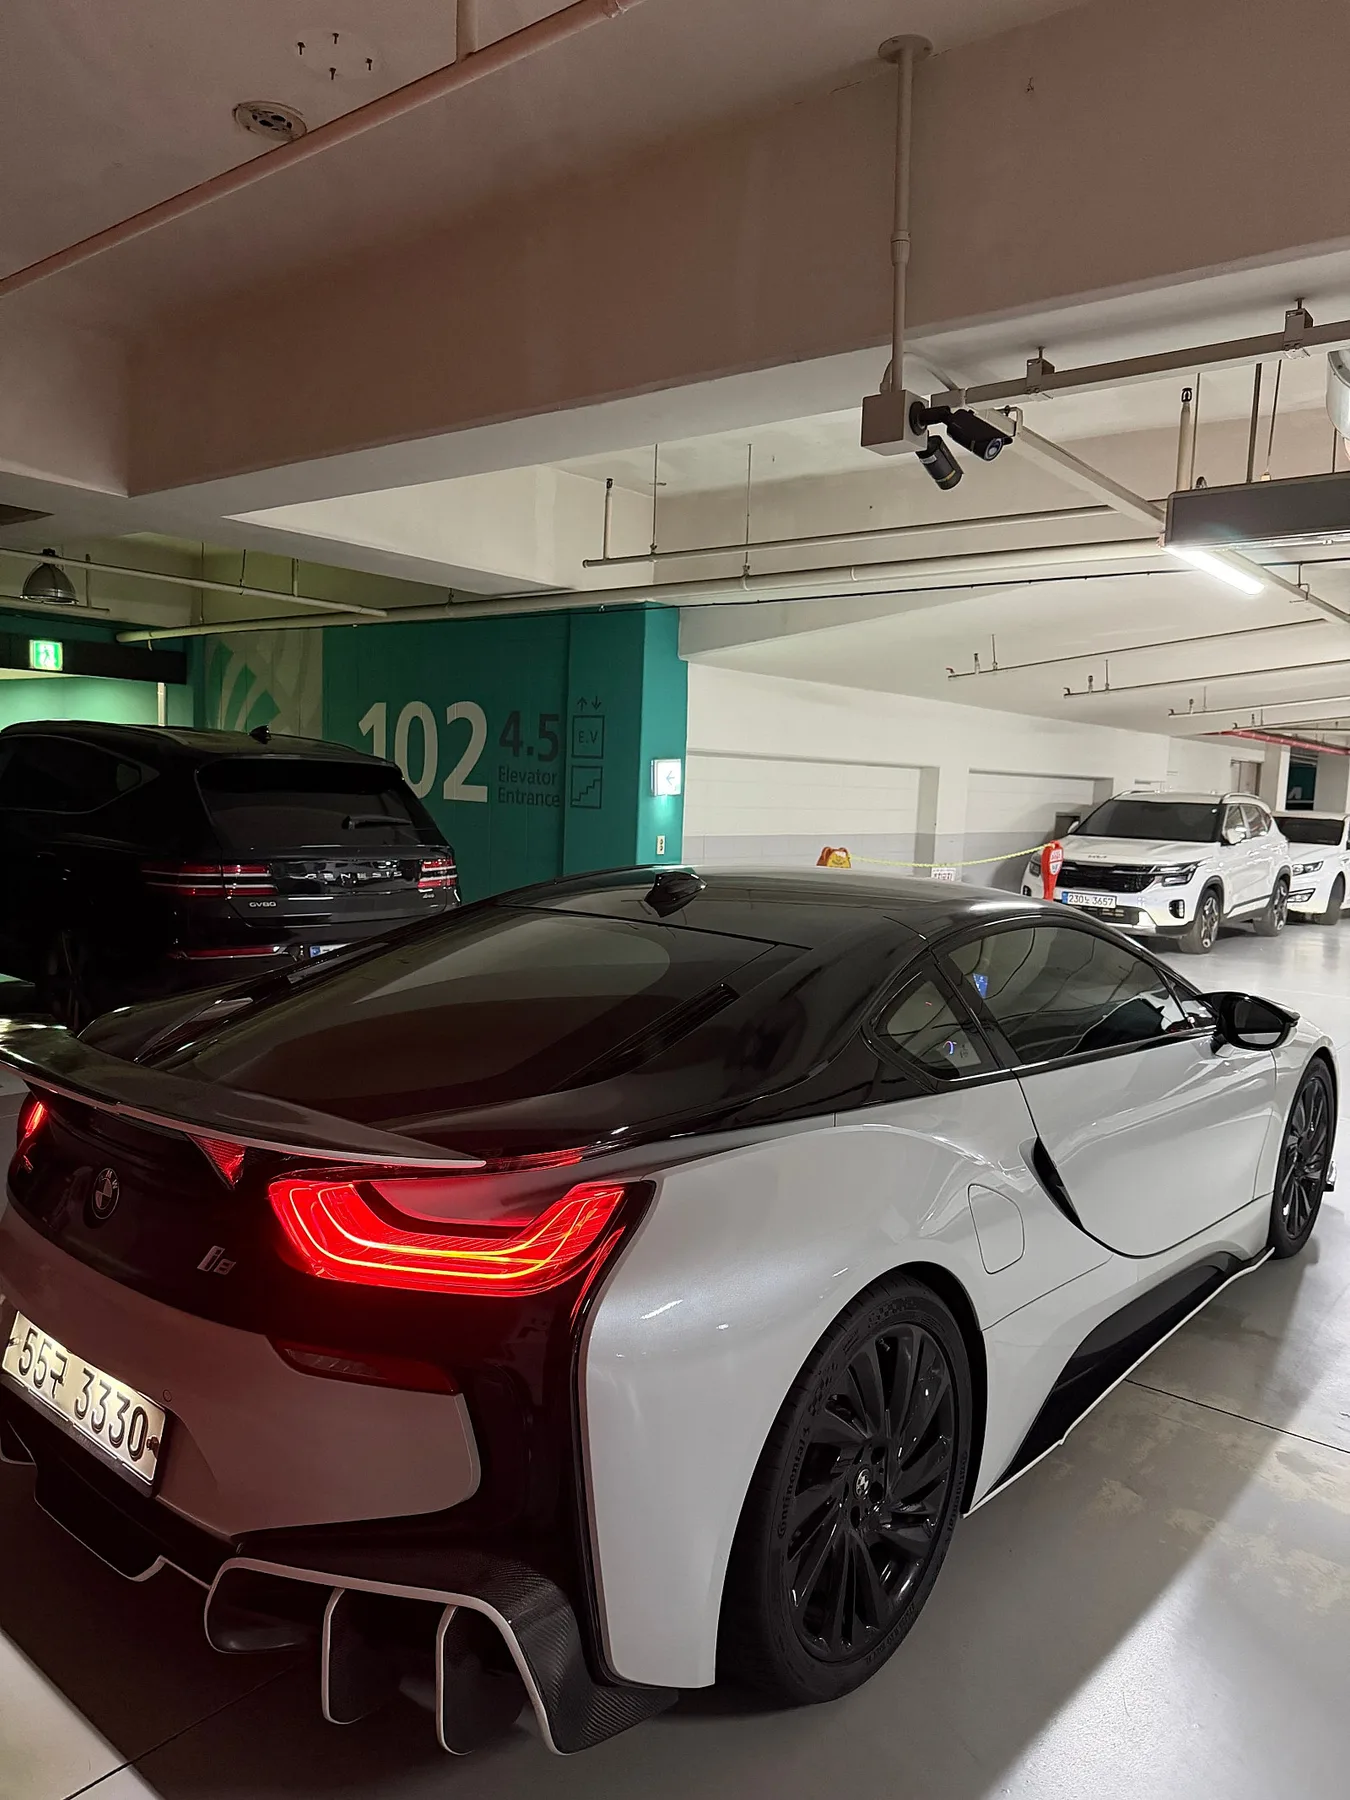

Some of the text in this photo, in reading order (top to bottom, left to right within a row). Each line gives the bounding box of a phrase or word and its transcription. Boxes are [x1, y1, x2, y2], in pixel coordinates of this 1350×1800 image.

[358, 700, 560, 803] 102 4.5
[498, 765, 557, 785] Elevator
[498, 786, 560, 808] Entrance
[1092, 896, 1114, 906] 3657
[18, 1327, 149, 1462] 55구 3330
